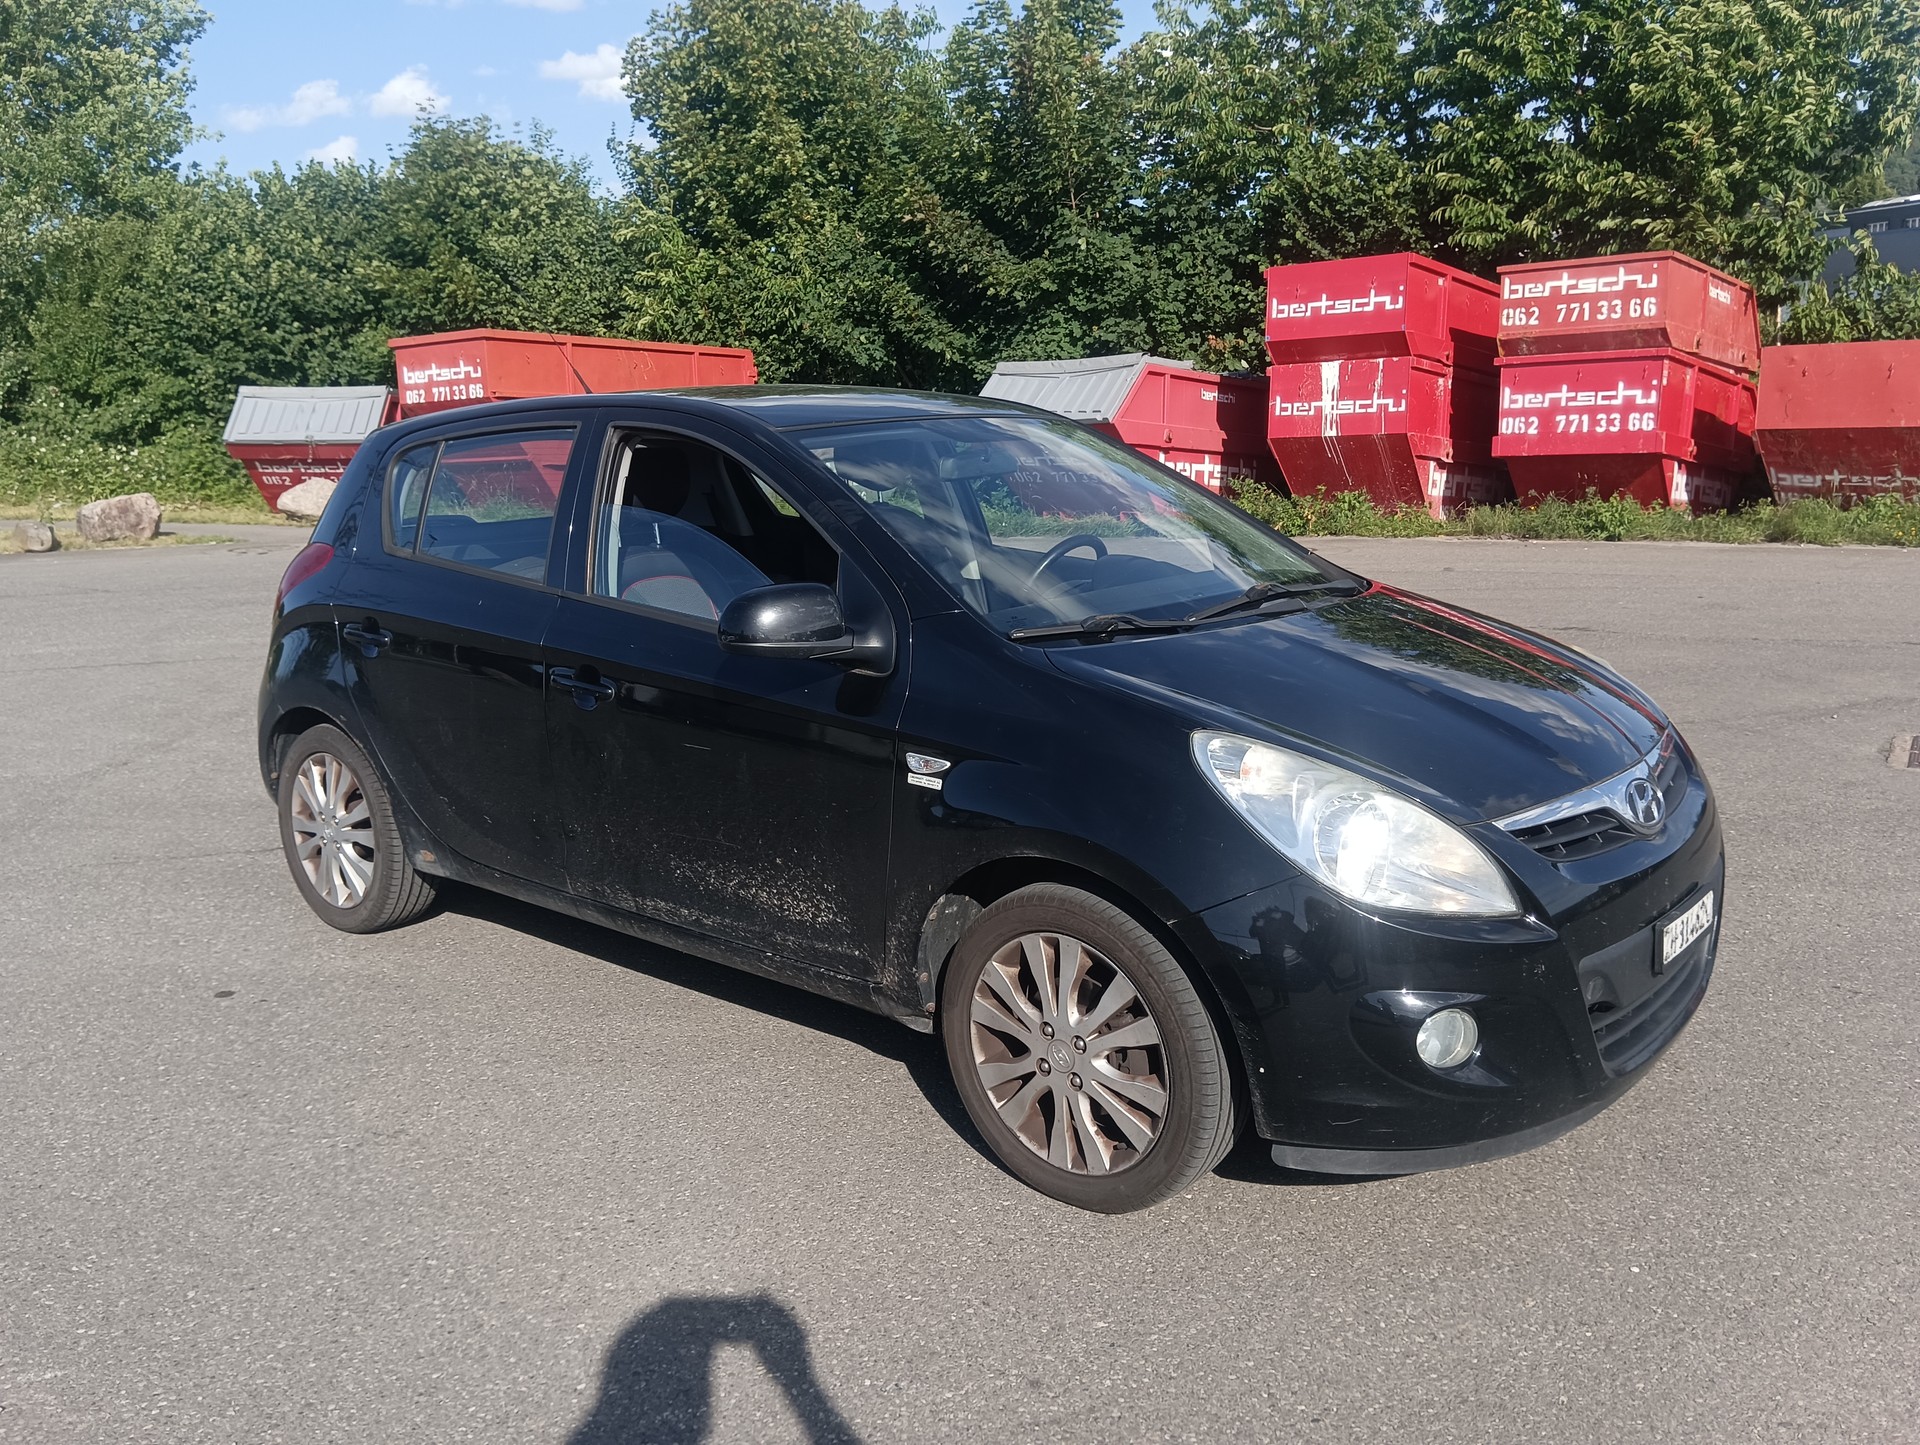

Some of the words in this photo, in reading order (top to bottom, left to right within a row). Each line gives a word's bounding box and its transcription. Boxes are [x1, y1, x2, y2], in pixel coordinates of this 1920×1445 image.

[1503, 263, 1658, 300] bertschi
[1271, 285, 1405, 319] bertschi
[1502, 307, 1540, 327] 062
[1556, 302, 1590, 323] 771
[1596, 299, 1622, 320] 33
[1629, 297, 1657, 318] 66
[402, 358, 482, 385] bertschi
[406, 389, 426, 405] 062
[432, 386, 450, 402] 771
[452, 385, 467, 400] 33
[469, 383, 484, 399] 66
[1201, 387, 1236, 405] bertschi
[1274, 389, 1407, 417] bertschi
[1503, 379, 1658, 409] bertschi
[1501, 416, 1539, 435] 062
[1555, 414, 1589, 433] 771
[1595, 412, 1621, 433] 33
[1628, 412, 1655, 431] 66
[254, 460, 348, 473] bertsch
[1770, 467, 1920, 487] bertsch
[261, 475, 293, 486] 062
